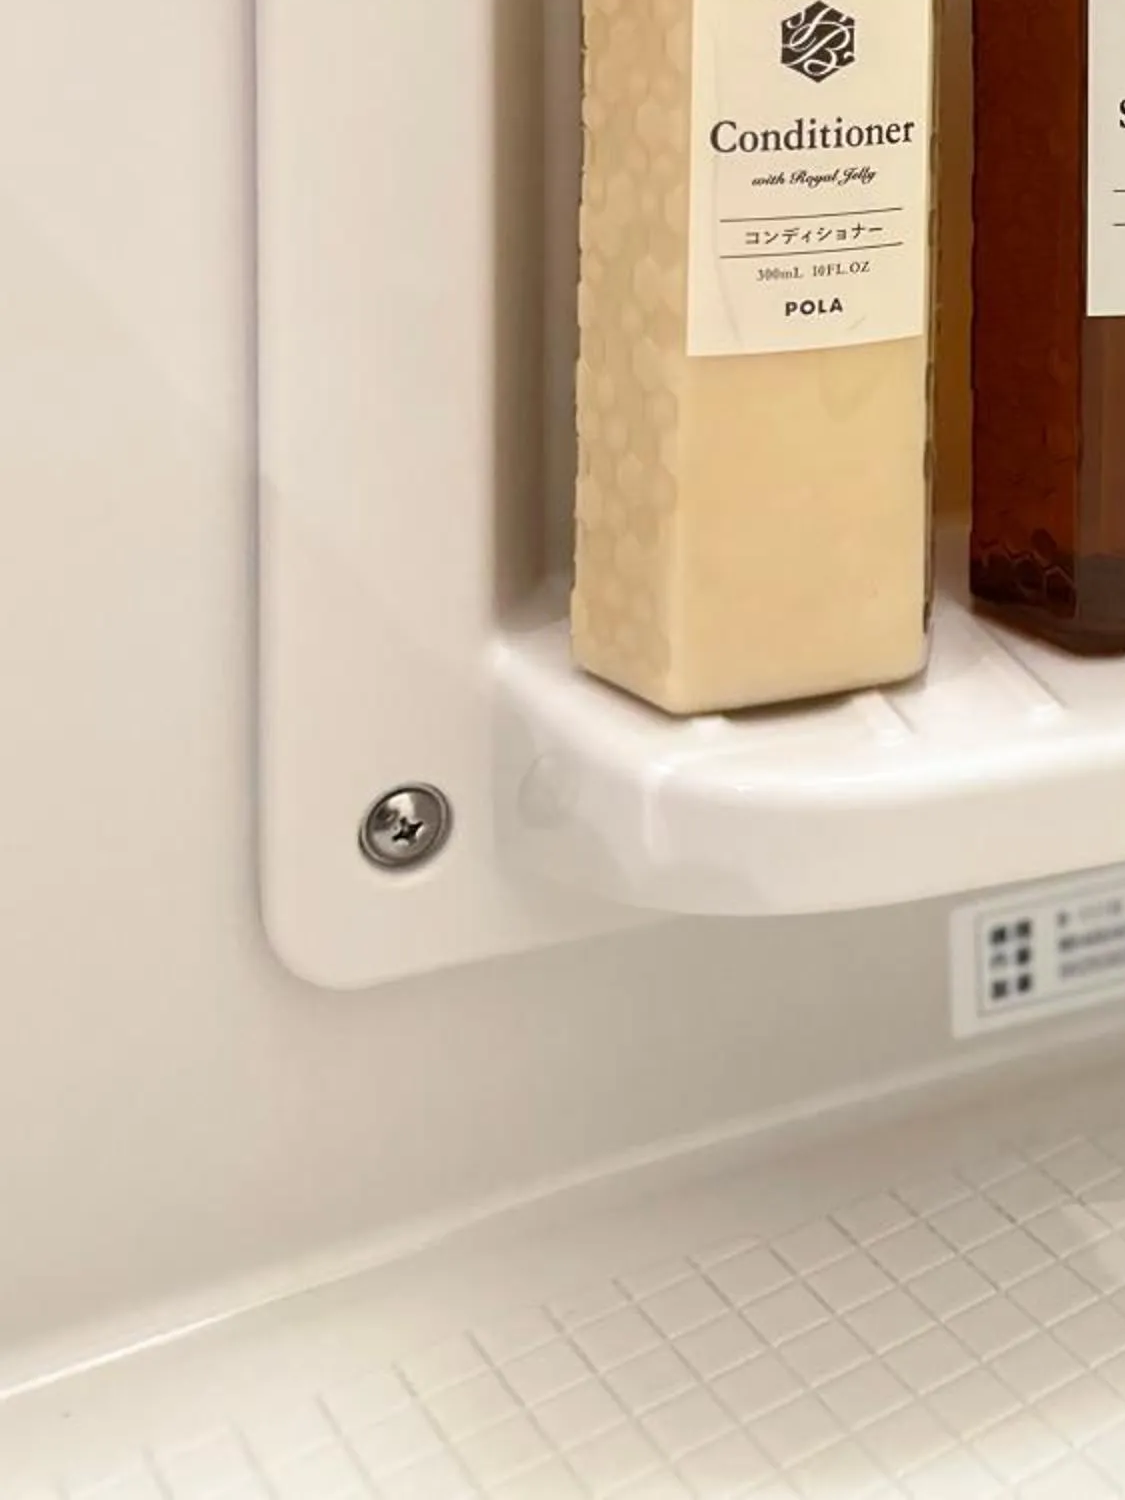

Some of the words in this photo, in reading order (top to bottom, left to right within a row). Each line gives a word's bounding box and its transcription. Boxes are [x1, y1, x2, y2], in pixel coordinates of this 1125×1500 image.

[709, 116, 915, 154] Conditioner
[751, 171, 786, 186] with
[789, 168, 840, 189] Royal
[837, 165, 877, 186] Jelly
[744, 222, 884, 245] コンディショナー
[756, 266, 804, 282] 300mL
[784, 297, 844, 317] POLA
